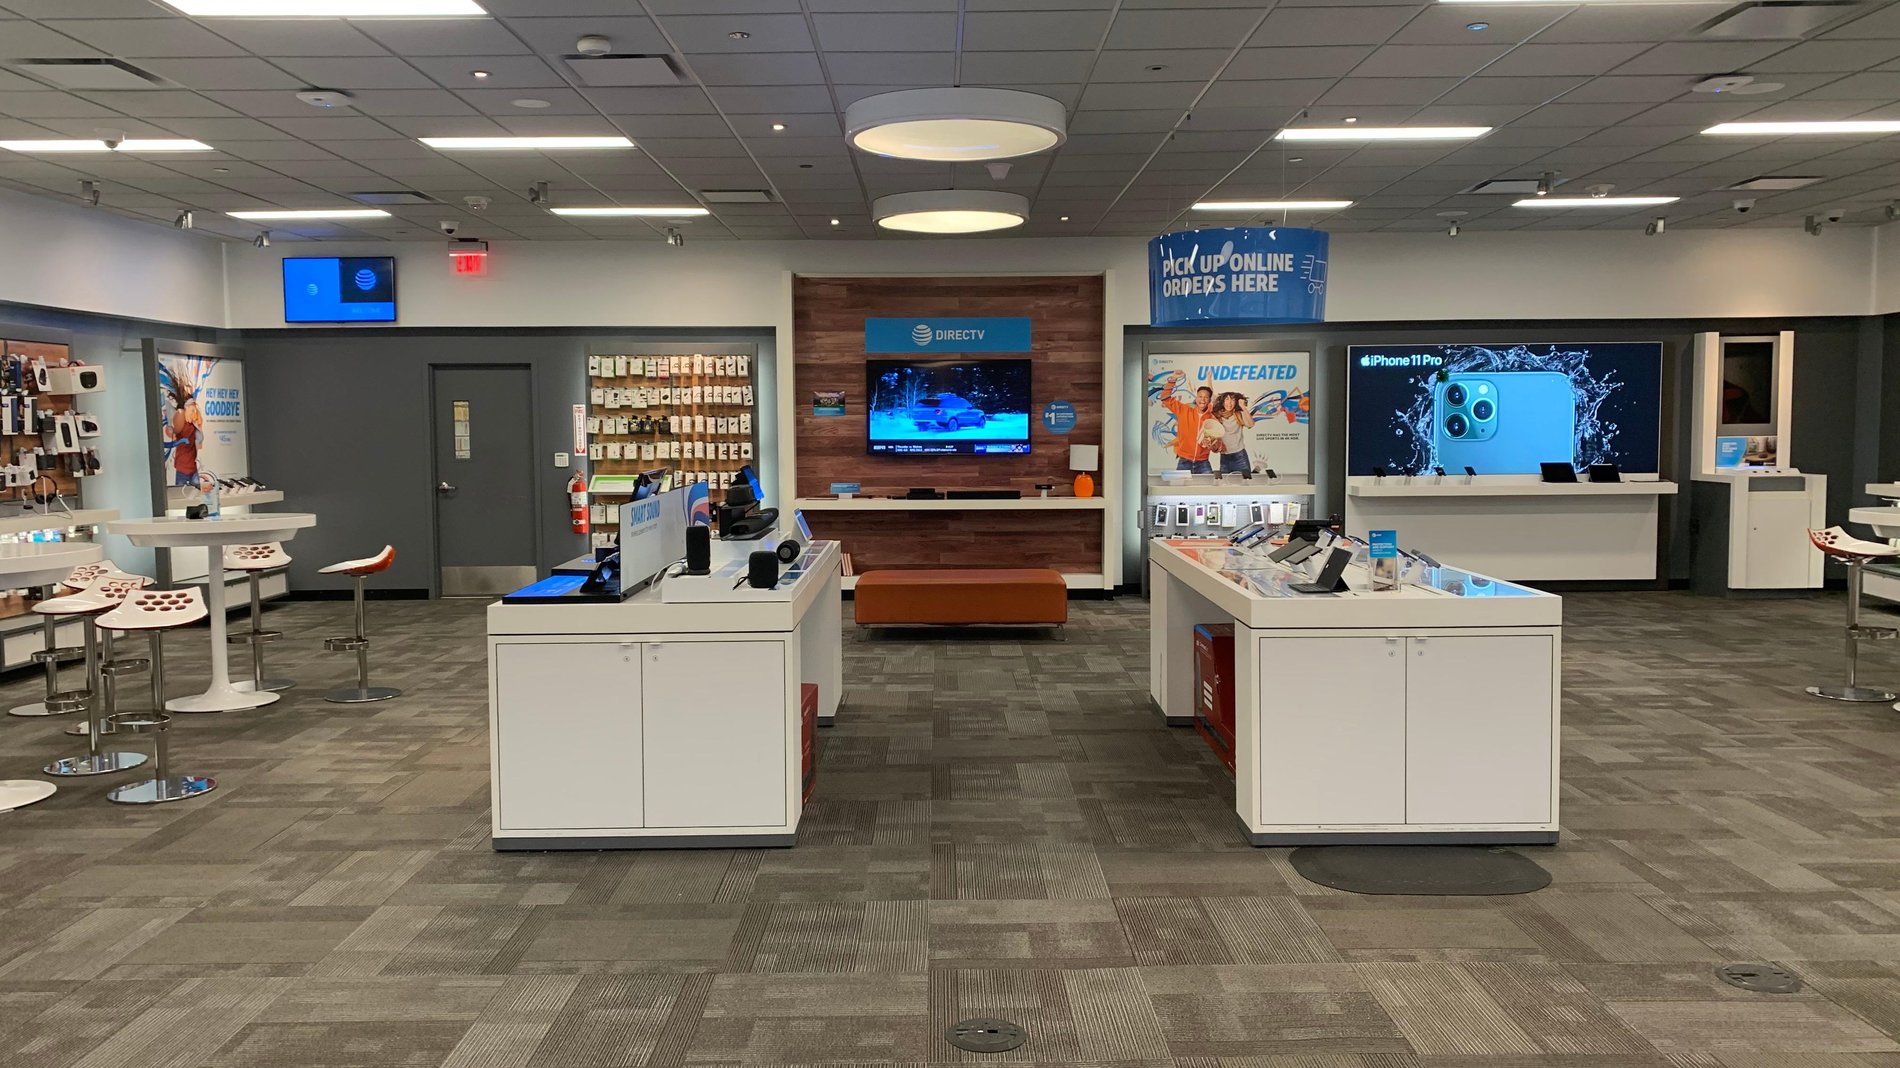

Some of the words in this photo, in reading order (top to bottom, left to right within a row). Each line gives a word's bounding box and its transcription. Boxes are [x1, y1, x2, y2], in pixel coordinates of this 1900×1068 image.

[1163, 257, 1196, 277] PICK
[1200, 254, 1224, 273] UP
[1229, 253, 1294, 272] ONLINE
[1163, 274, 1226, 297] ORDERS
[1231, 274, 1279, 292] HERE
[936, 329, 985, 341] DIRECTV
[1370, 355, 1410, 366] iPhone
[1410, 354, 1421, 366] 11
[1422, 354, 1443, 366] Pro
[1197, 364, 1297, 381] UNDEFEATED
[206, 388, 216, 398] HEY
[217, 388, 228, 398] HEY
[229, 388, 240, 399] HEY
[204, 401, 240, 416] GOODBYE
[630, 503, 646, 527] SMART
[646, 500, 660, 521] SOUND
